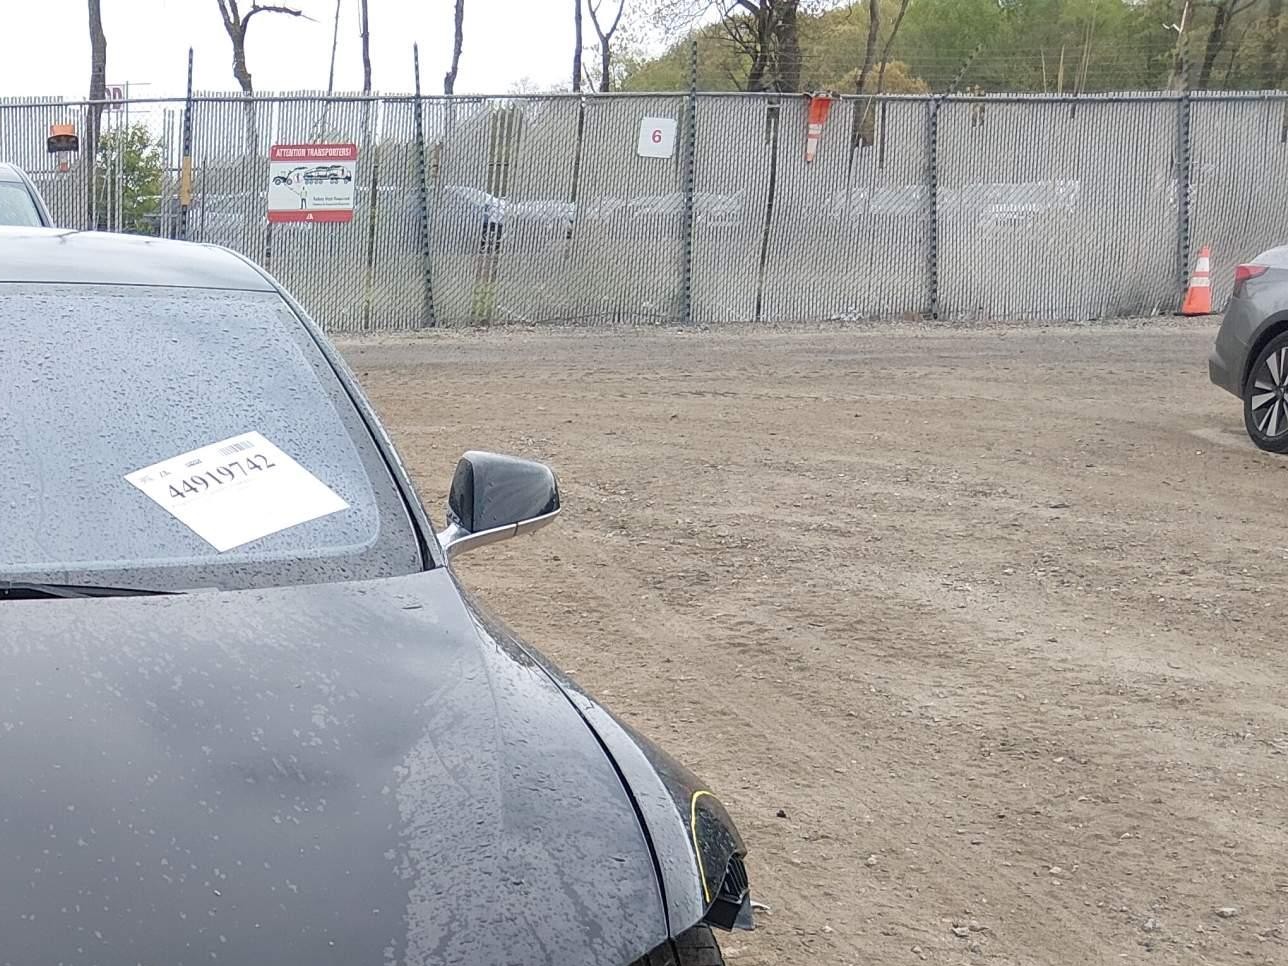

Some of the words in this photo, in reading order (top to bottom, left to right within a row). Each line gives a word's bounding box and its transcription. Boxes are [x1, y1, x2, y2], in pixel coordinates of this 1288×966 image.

[651, 129, 663, 144] 6
[275, 148, 306, 157] ATTENTION
[169, 454, 276, 499] 44919742
